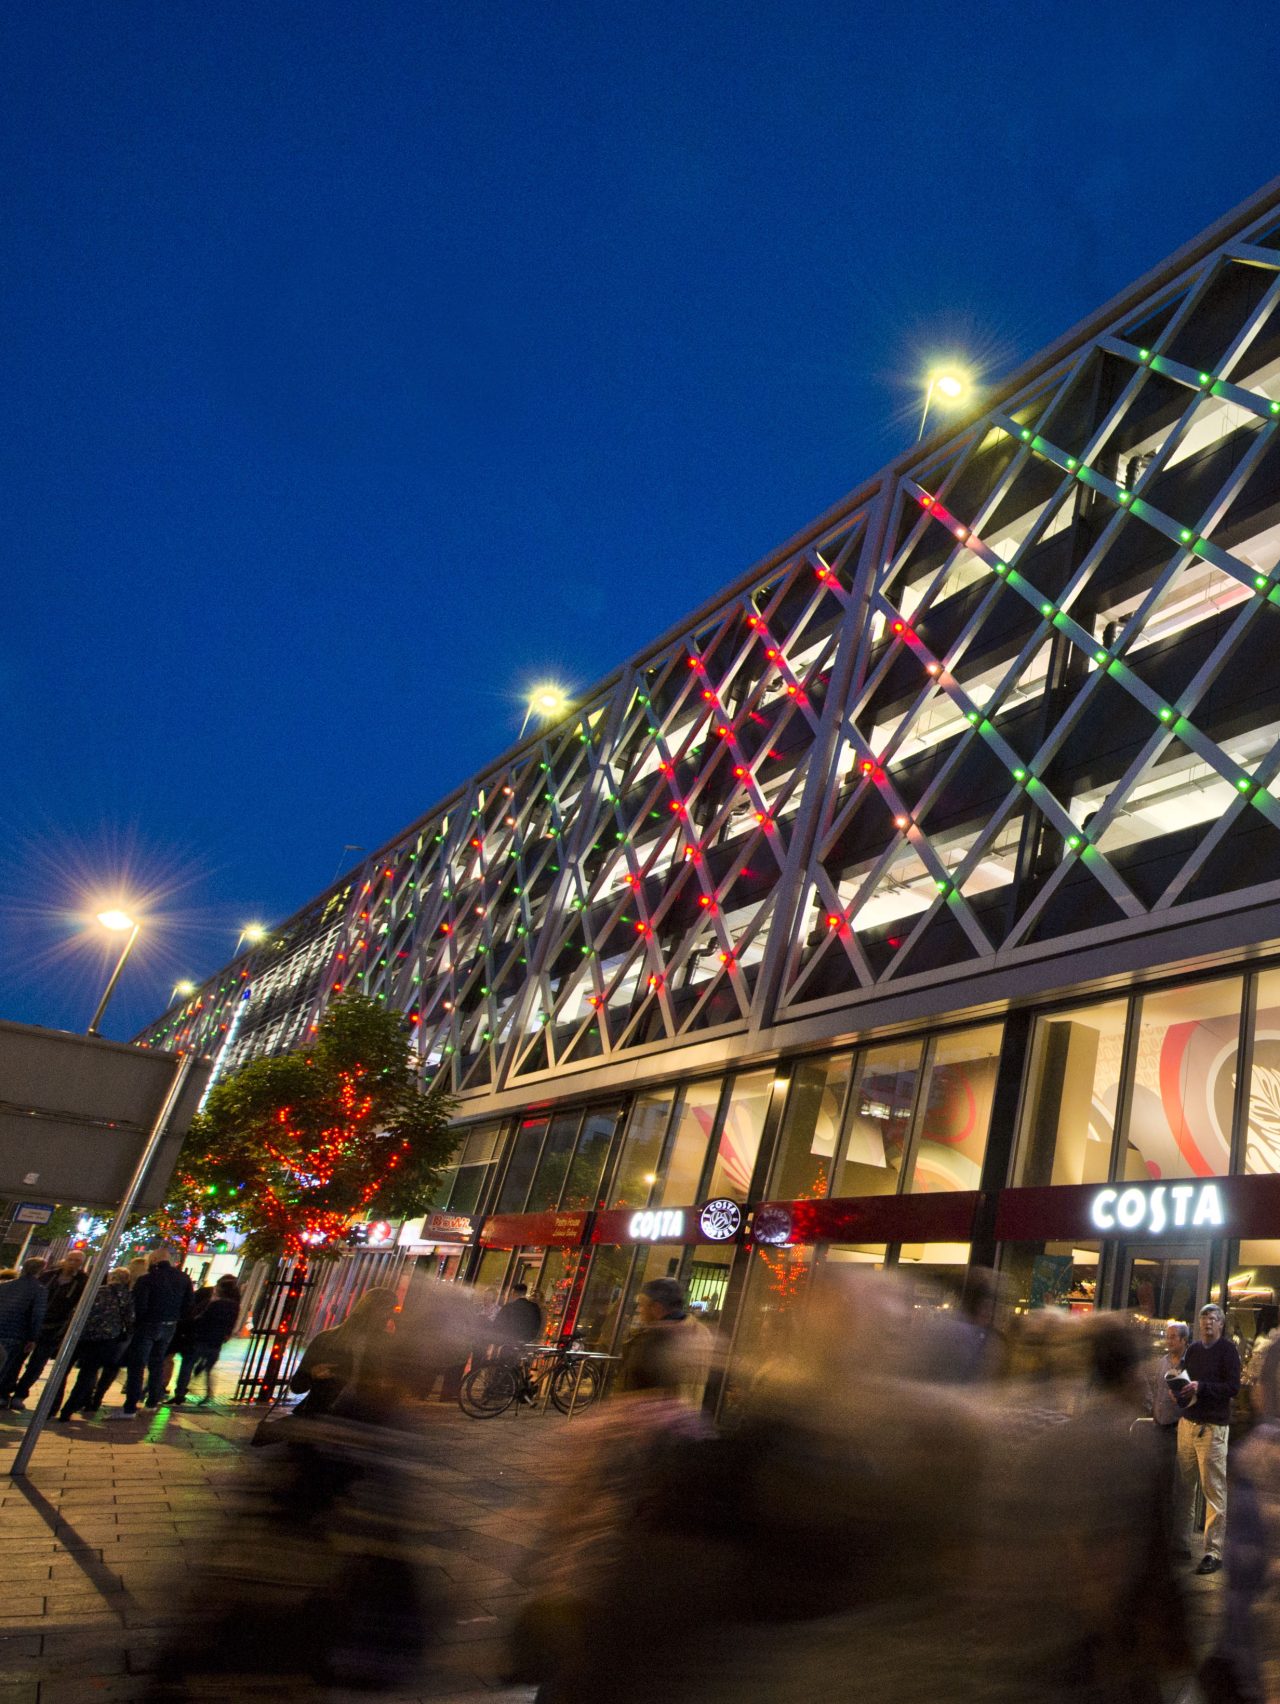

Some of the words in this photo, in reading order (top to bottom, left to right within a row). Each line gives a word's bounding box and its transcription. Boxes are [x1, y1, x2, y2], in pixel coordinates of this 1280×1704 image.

[708, 1200, 737, 1215] COSTA
[1091, 1184, 1224, 1233] COSTA
[629, 1210, 684, 1241] COSTA
[702, 1220, 737, 1239] COFFEE
